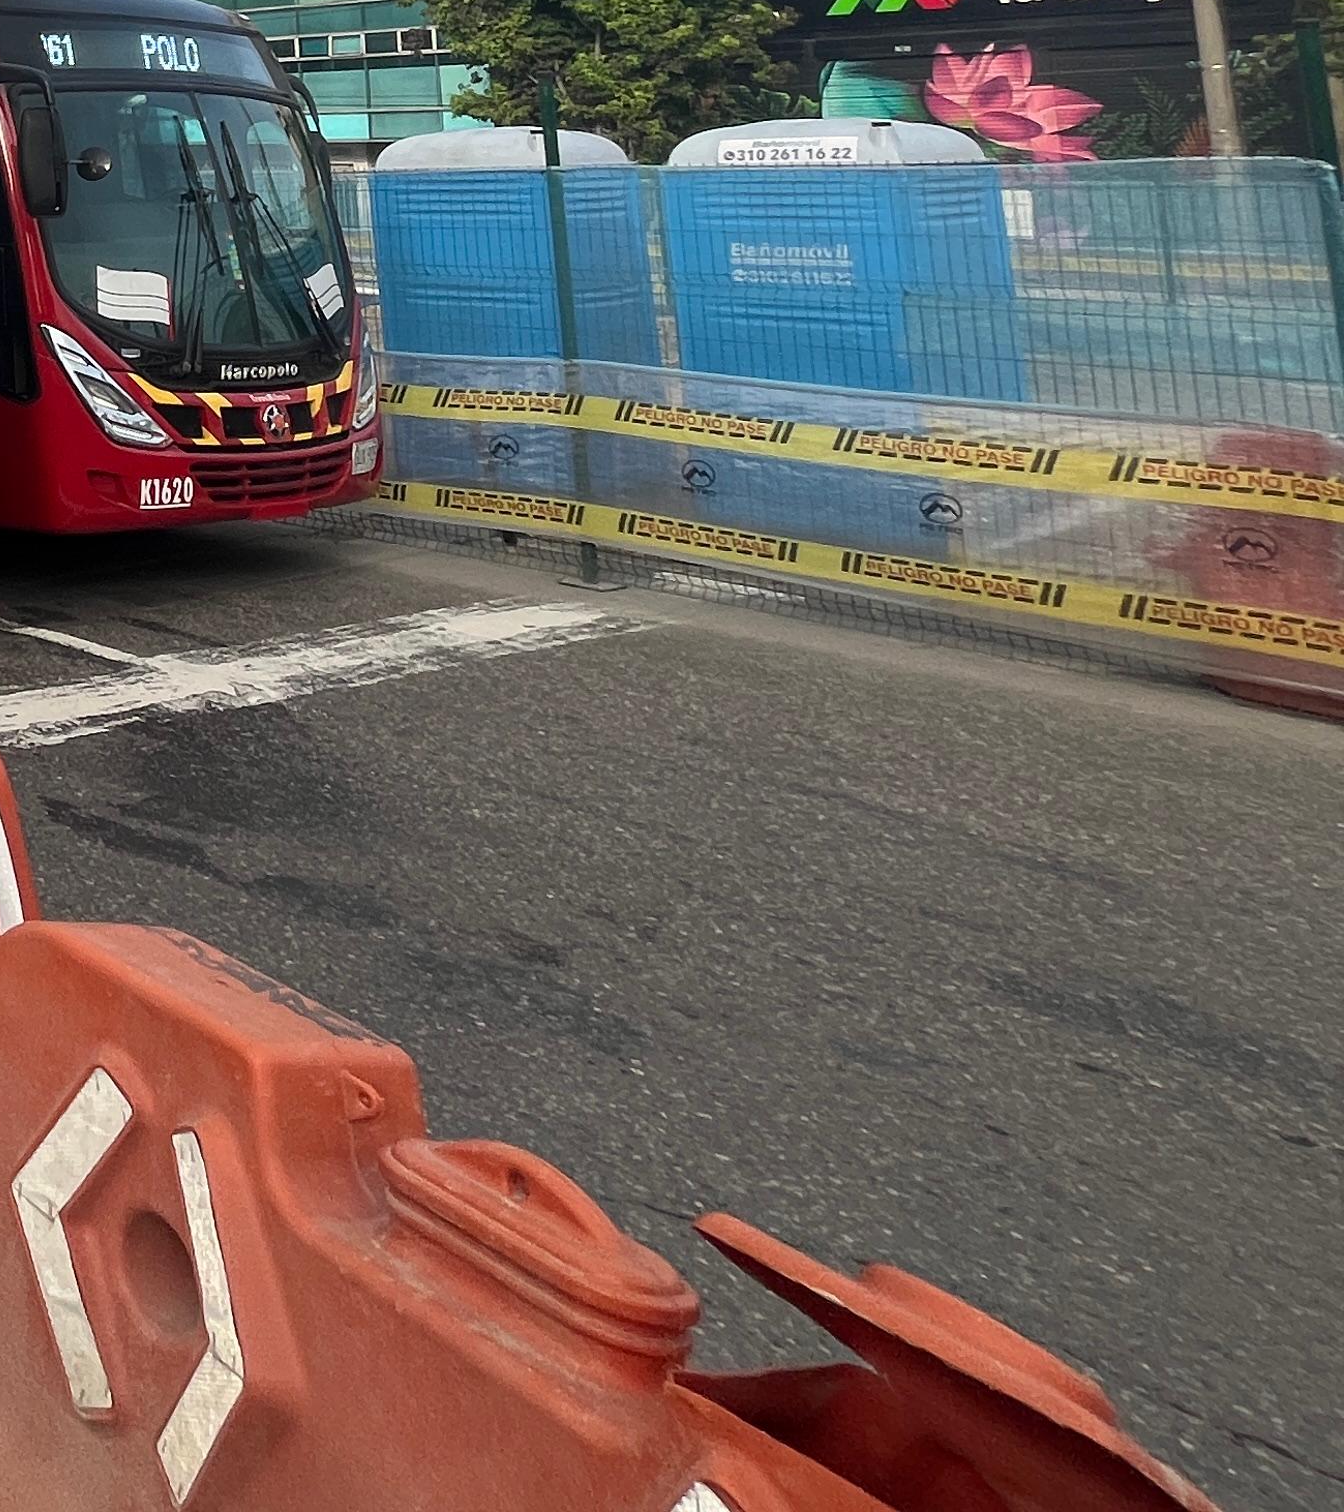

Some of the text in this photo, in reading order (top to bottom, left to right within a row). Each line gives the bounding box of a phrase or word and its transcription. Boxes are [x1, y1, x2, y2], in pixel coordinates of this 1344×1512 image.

[140, 33, 201, 72] POLO
[737, 147, 852, 161] 310 261 16 22
[219, 362, 299, 380] Marcopolo
[450, 391, 562, 409] PELIGRO NO PASE
[635, 407, 768, 436] PELIGRO NO PASE
[860, 436, 1025, 465] PELIGRO NO PASE
[140, 476, 193, 506] K1620
[1142, 464, 1240, 485] PELIGRO
[1247, 474, 1283, 489] NO
[452, 493, 563, 517] PELIGRO NO PASE
[638, 520, 773, 553] PELIGRO NO PASE
[866, 560, 1033, 597] PELIGRO NO PASE
[1151, 604, 1250, 630] PELIGRO
[1258, 619, 1293, 637] NO
